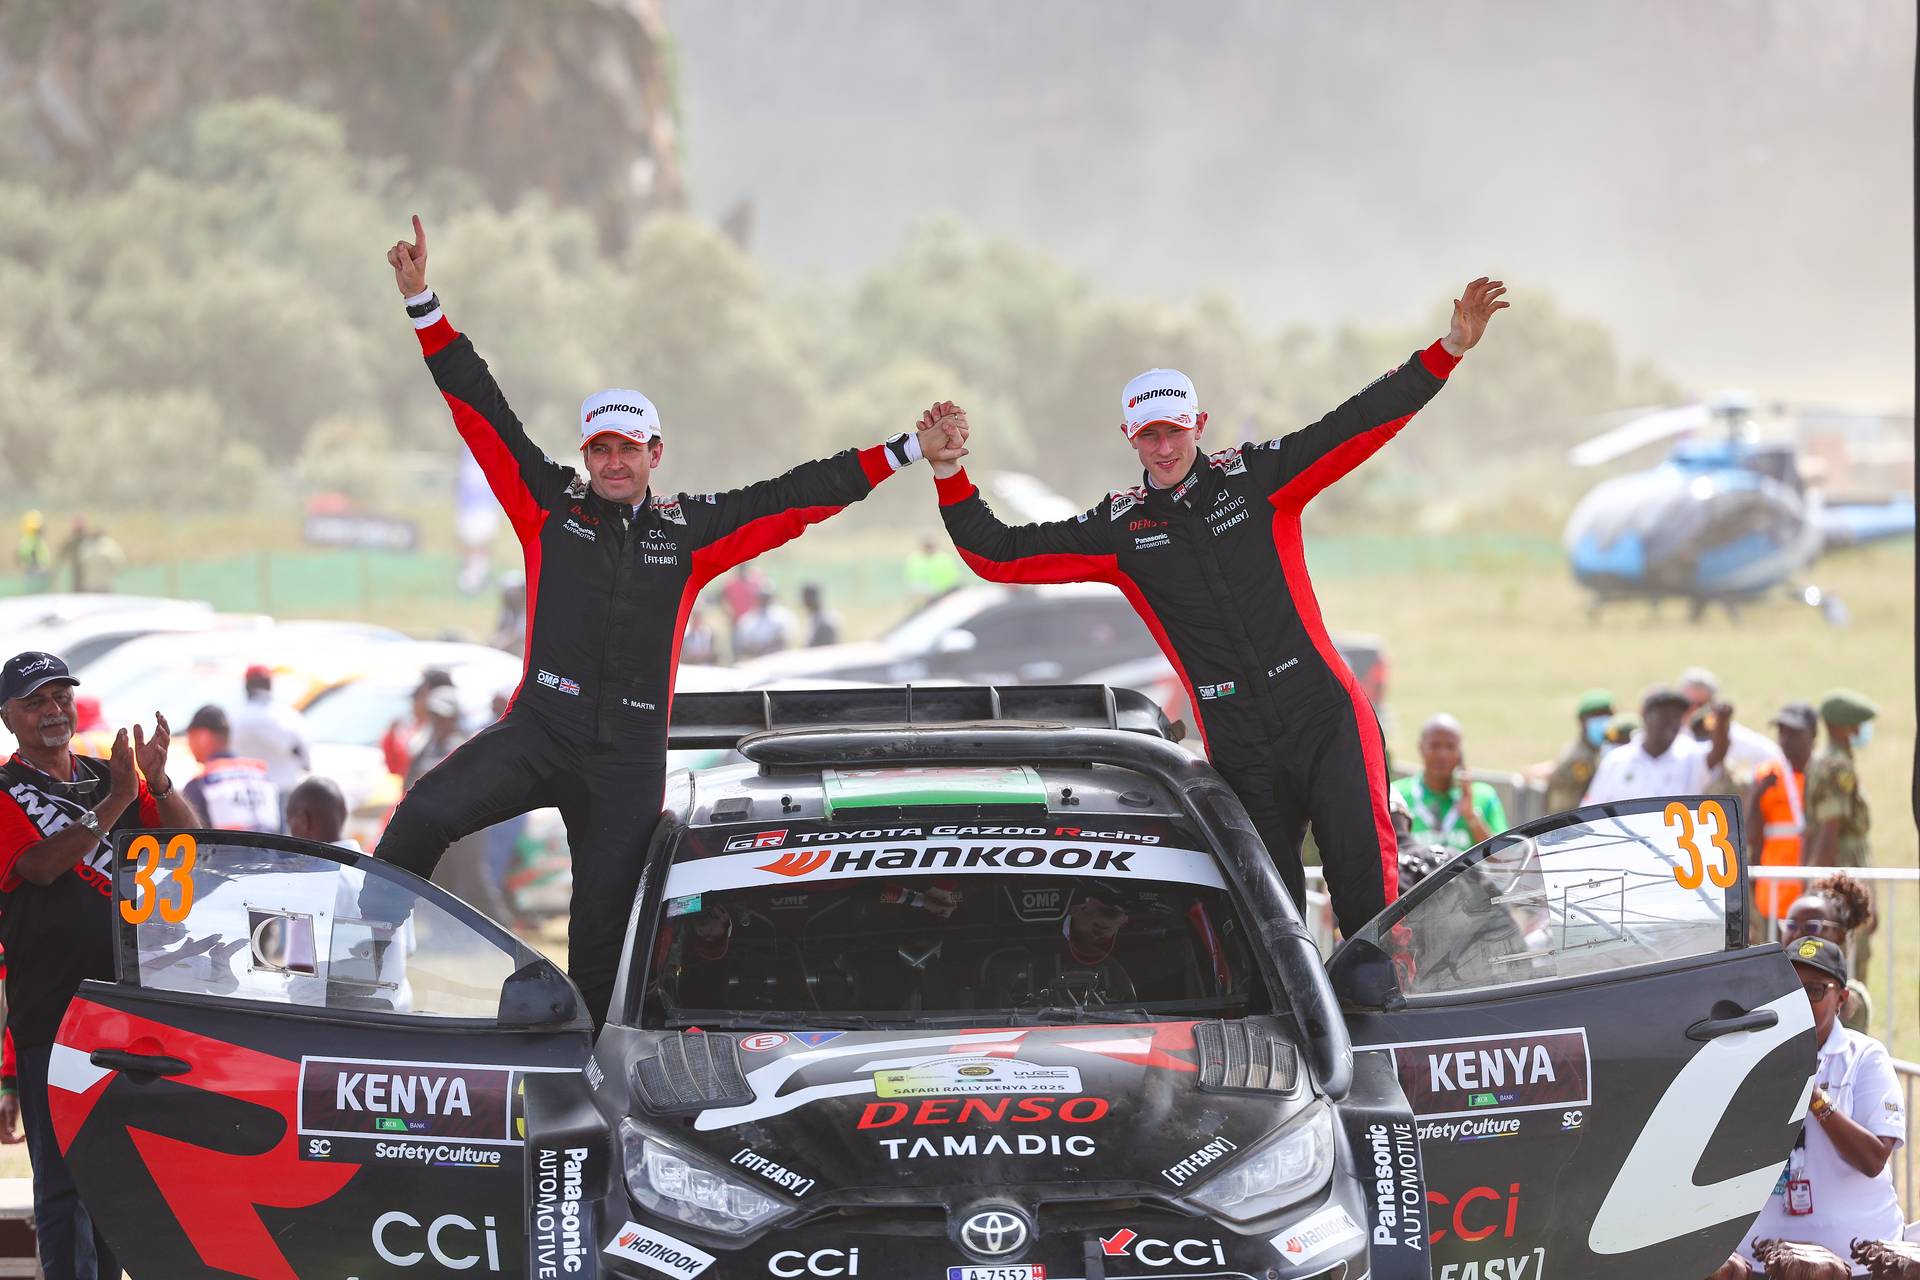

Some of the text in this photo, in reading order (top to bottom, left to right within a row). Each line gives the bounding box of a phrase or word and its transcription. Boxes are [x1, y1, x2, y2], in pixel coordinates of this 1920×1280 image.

[1112, 498, 1132, 513] OMP
[1205, 496, 1246, 523] TAMADIC
[640, 541, 677, 551] TAMADC
[1135, 532, 1168, 545] Panasonic
[1135, 538, 1171, 550] AUTOMOTIVE
[537, 672, 560, 686] OMP
[1267, 657, 1299, 678] E. EVANS
[622, 698, 655, 711] S. MARTIN
[725, 834, 785, 850] GR
[795, 827, 923, 842] TOYOTA
[1053, 826, 1161, 844] Racing
[1663, 799, 1739, 891] 33
[119, 833, 199, 925] 33
[1022, 892, 1060, 908] OMP
[1428, 1045, 1557, 1093] KENYA
[335, 1071, 472, 1117] KENYA
[893, 1086, 939, 1094] SAFARI
[856, 1097, 1110, 1130] DENSO
[1561, 1110, 1583, 1127] SC
[1418, 1118, 1521, 1141] afetyCulture
[308, 1139, 331, 1154] SC
[375, 1142, 501, 1165] SafetyCulture
[879, 1134, 1096, 1160] TAMADIC
[1365, 1124, 1397, 1246] Panasonic
[1393, 1123, 1422, 1251] AUTOMOTIVE
[536, 1149, 558, 1280] AUTOMOTIVE
[561, 1147, 588, 1273] Panasonic
[371, 1211, 501, 1272] CCi
[1135, 1239, 1227, 1267] CCi
[768, 1247, 859, 1278] CCi
[970, 1269, 1027, 1280] A-7552
